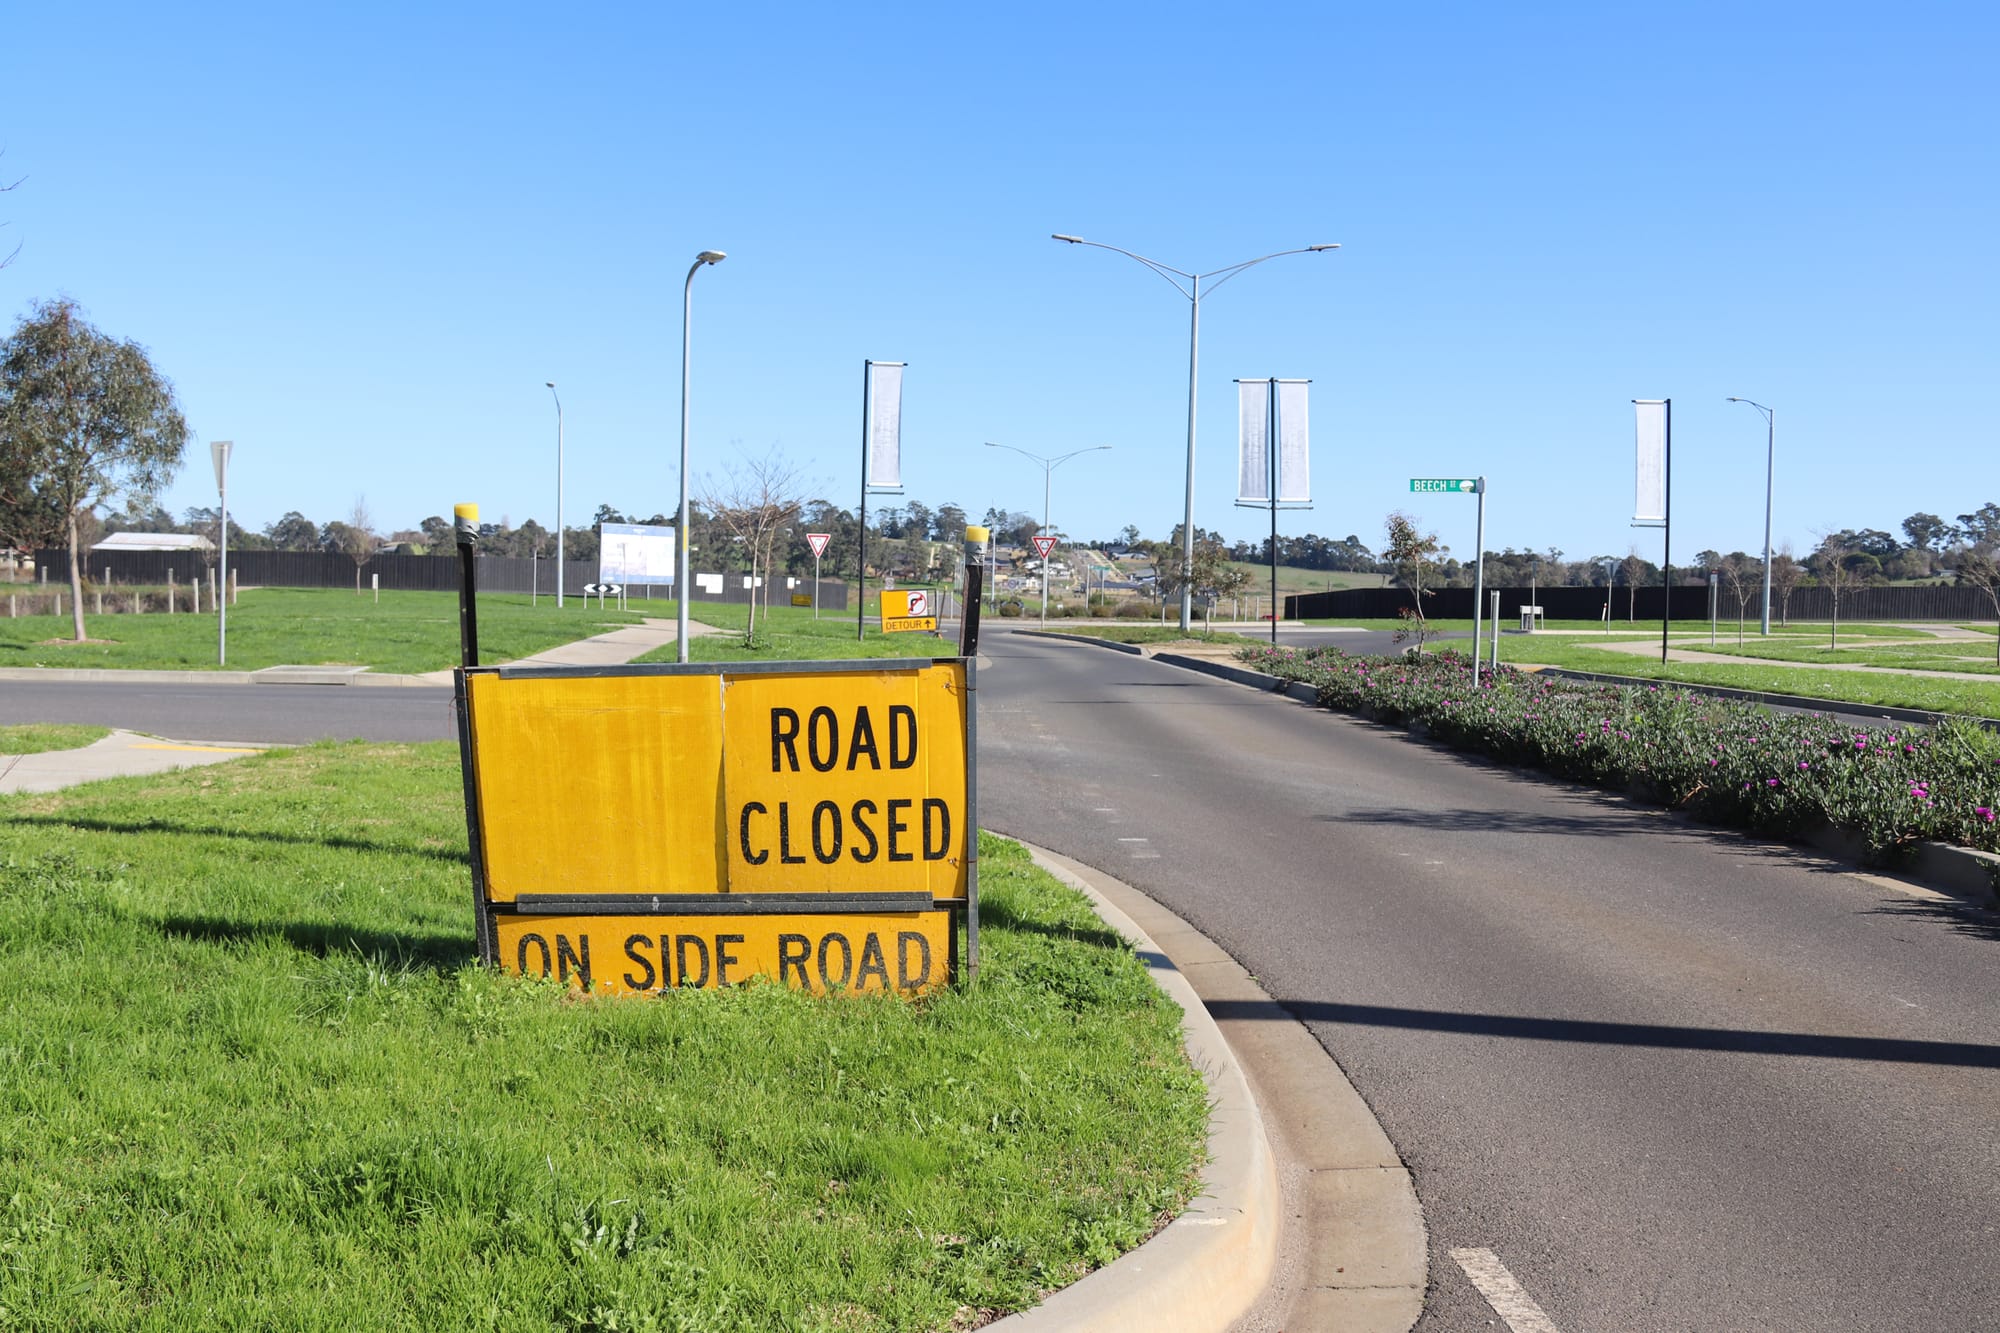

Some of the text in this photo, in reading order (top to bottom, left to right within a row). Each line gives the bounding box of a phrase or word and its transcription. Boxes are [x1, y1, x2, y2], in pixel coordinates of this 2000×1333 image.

[1414, 480, 1447, 491] BEECH
[886, 620, 922, 630] DETOUR
[770, 705, 918, 772] ROAD
[740, 798, 951, 865] CLOSED
[517, 931, 931, 993] ON SIDE ROAD
